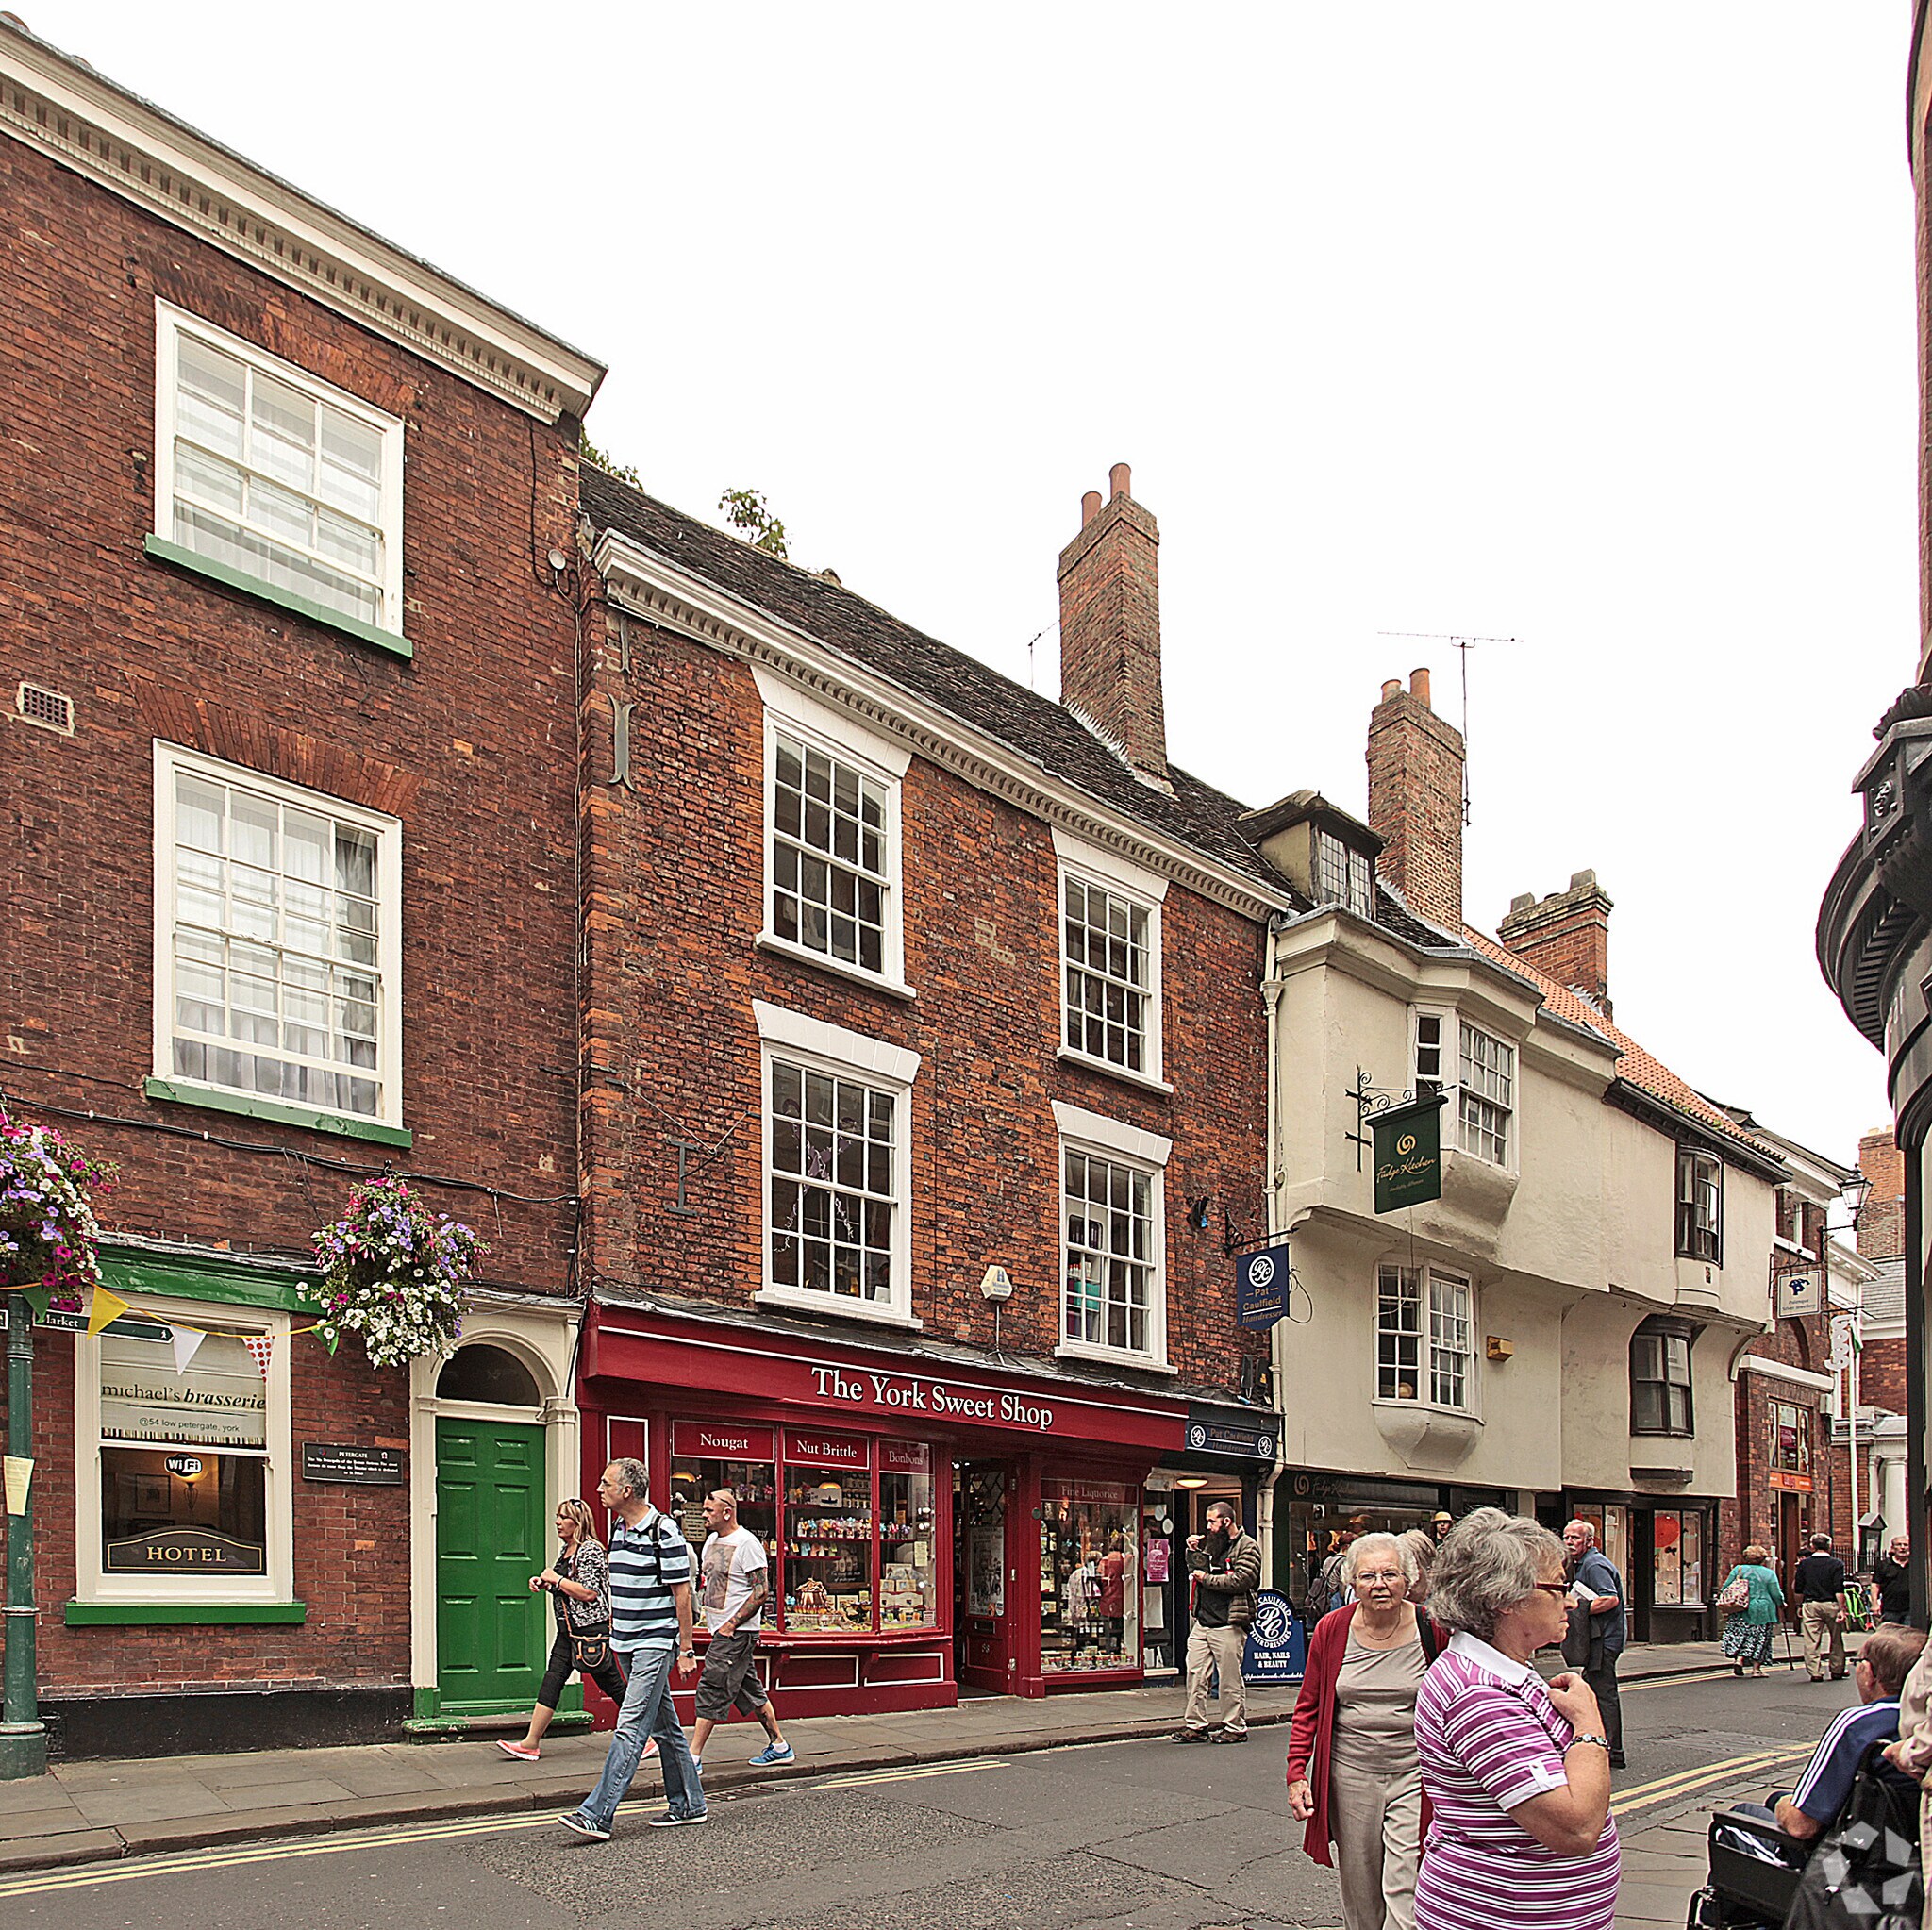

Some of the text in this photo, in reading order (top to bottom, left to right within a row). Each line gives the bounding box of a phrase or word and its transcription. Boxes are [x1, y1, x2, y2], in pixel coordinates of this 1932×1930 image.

[1376, 1156, 1436, 1184] Fudge Kitchen
[1254, 1287, 1269, 1297] Pat
[1242, 1295, 1281, 1311] Caulfield
[101, 1384, 266, 1409] michael's brasserie
[811, 1367, 1053, 1431] The York Sweet Shop
[139, 1417, 240, 1433] @54 low petergate, york
[700, 1433, 749, 1451] Nougat
[1210, 1428, 1254, 1442] Pat Caulfield
[796, 1439, 857, 1458] Nut Brittle
[889, 1451, 924, 1465] Bonbons
[1061, 1485, 1118, 1499] Fine Liquorice
[146, 1546, 226, 1562] HOTEL
[1257, 1595, 1291, 1617] CAULFIELD
[1250, 1630, 1292, 1649] HAIRDRESSERS
[1272, 1651, 1291, 1659] NAILS
[1263, 1660, 1287, 1669] BEAUTY
